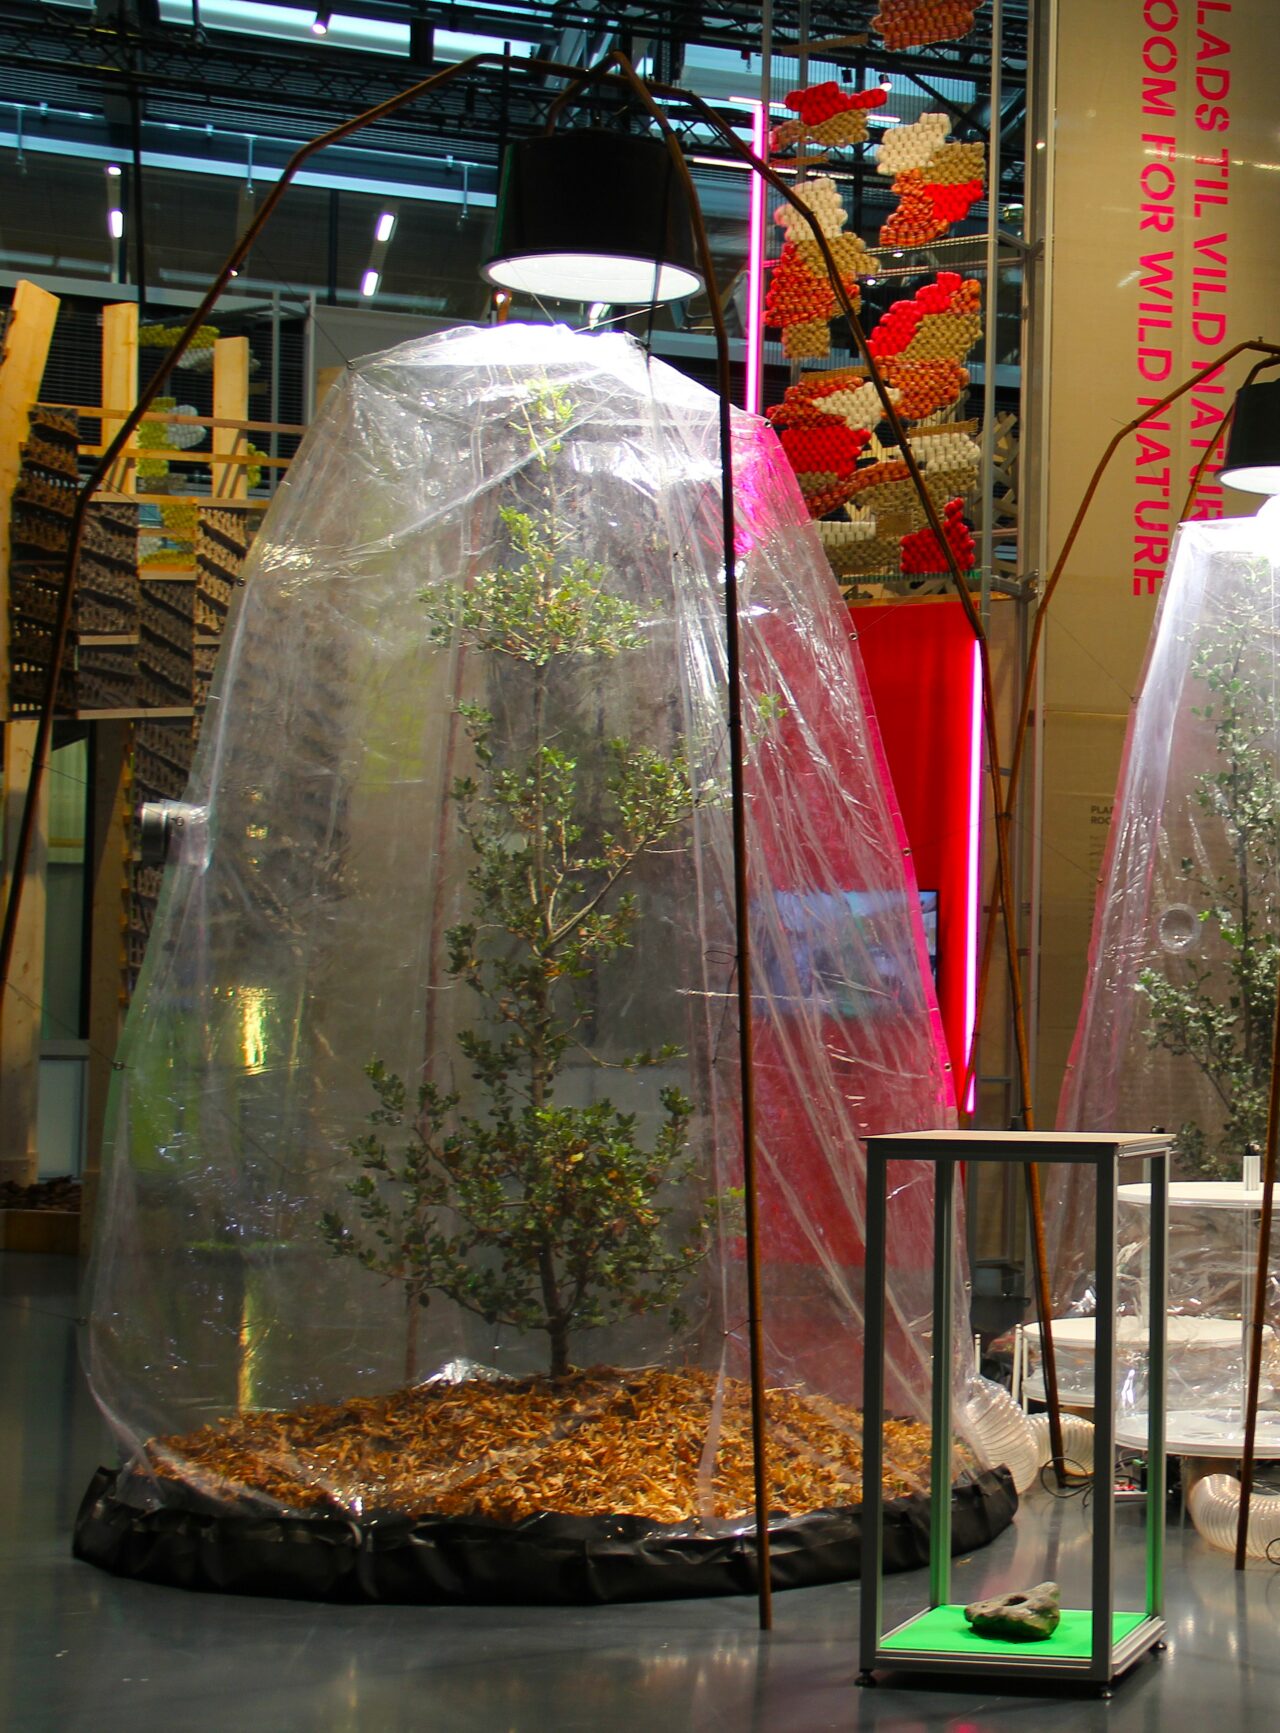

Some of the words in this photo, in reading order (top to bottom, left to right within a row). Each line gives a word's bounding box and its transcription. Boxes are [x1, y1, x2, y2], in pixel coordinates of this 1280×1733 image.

[1142, 0, 1178, 117] OOM
[1139, 133, 1176, 233] FOR
[1194, 148, 1230, 218] TIL
[1137, 251, 1174, 383] WILD
[1192, 232, 1228, 346] VILD
[1132, 397, 1171, 597] NATURE
